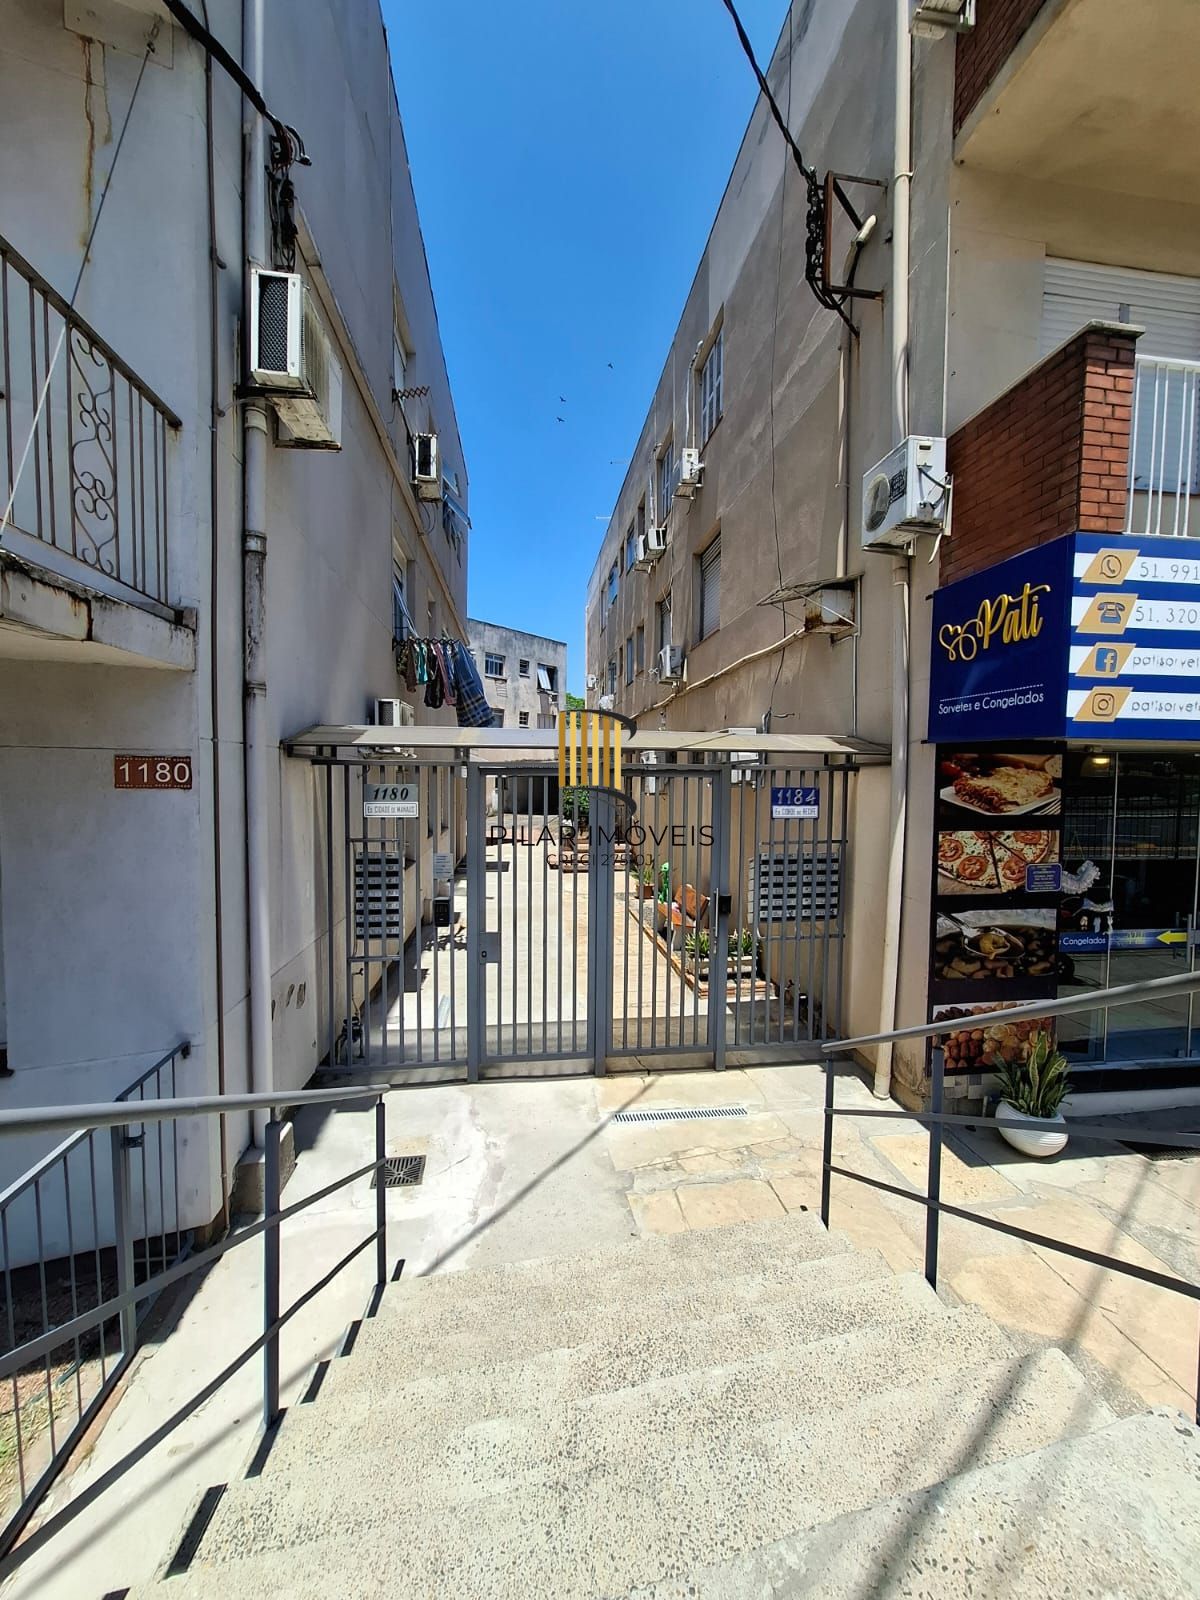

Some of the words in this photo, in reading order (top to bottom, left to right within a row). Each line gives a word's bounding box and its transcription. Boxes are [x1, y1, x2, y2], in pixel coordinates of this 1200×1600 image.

[966, 582, 1051, 650] Pati
[1135, 606, 1200, 624] 51.320
[938, 702, 972, 715] Sorvetes
[974, 701, 980, 710] e
[982, 690, 1044, 709] Congelados
[1131, 701, 1200, 713] patisorvet
[119, 762, 190, 783] 1180
[373, 787, 409, 800] 1180
[777, 788, 816, 805] 1184
[1062, 936, 1106, 946] Congelados
